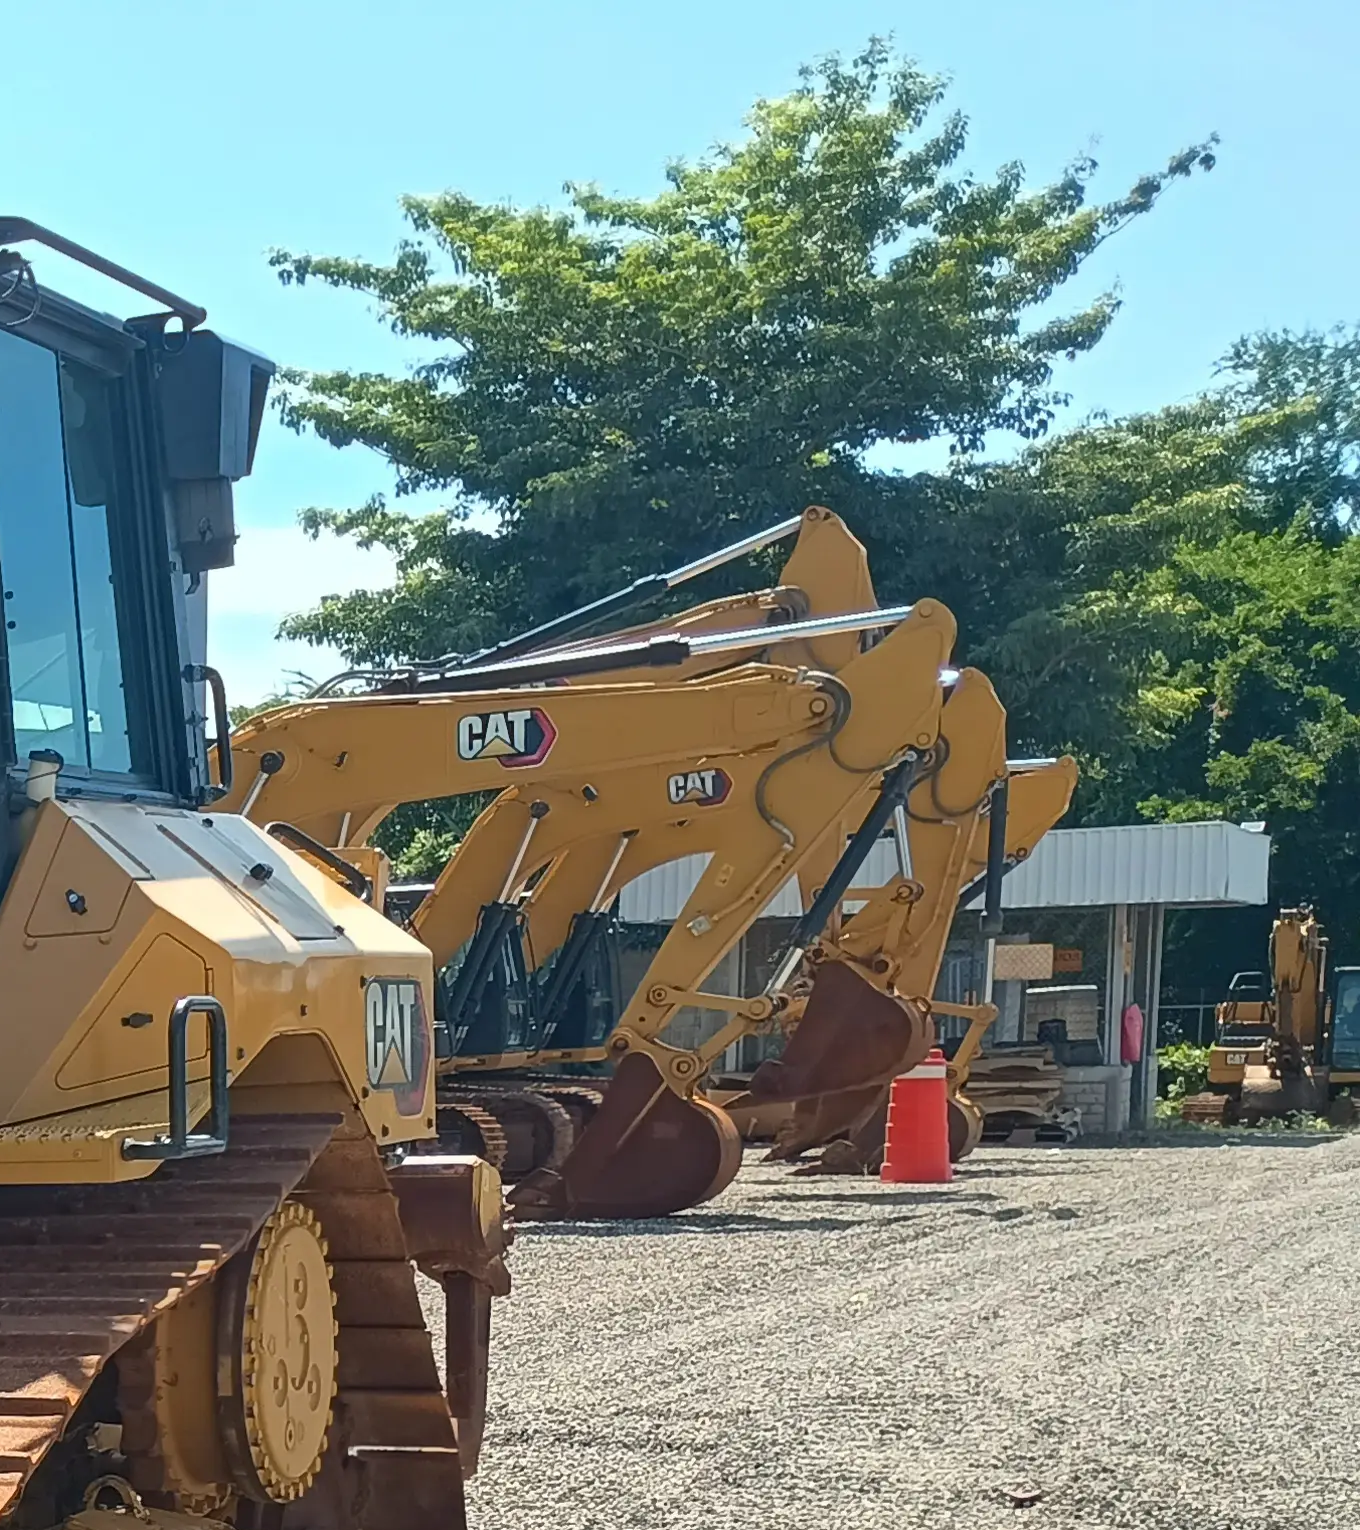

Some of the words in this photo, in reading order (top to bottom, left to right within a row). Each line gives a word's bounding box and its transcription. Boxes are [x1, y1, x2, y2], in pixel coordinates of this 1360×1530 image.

[459, 709, 531, 759] CAT
[669, 770, 716, 803] CAT
[366, 982, 415, 1085] CAT
[1226, 1053, 1247, 1065] CAT
